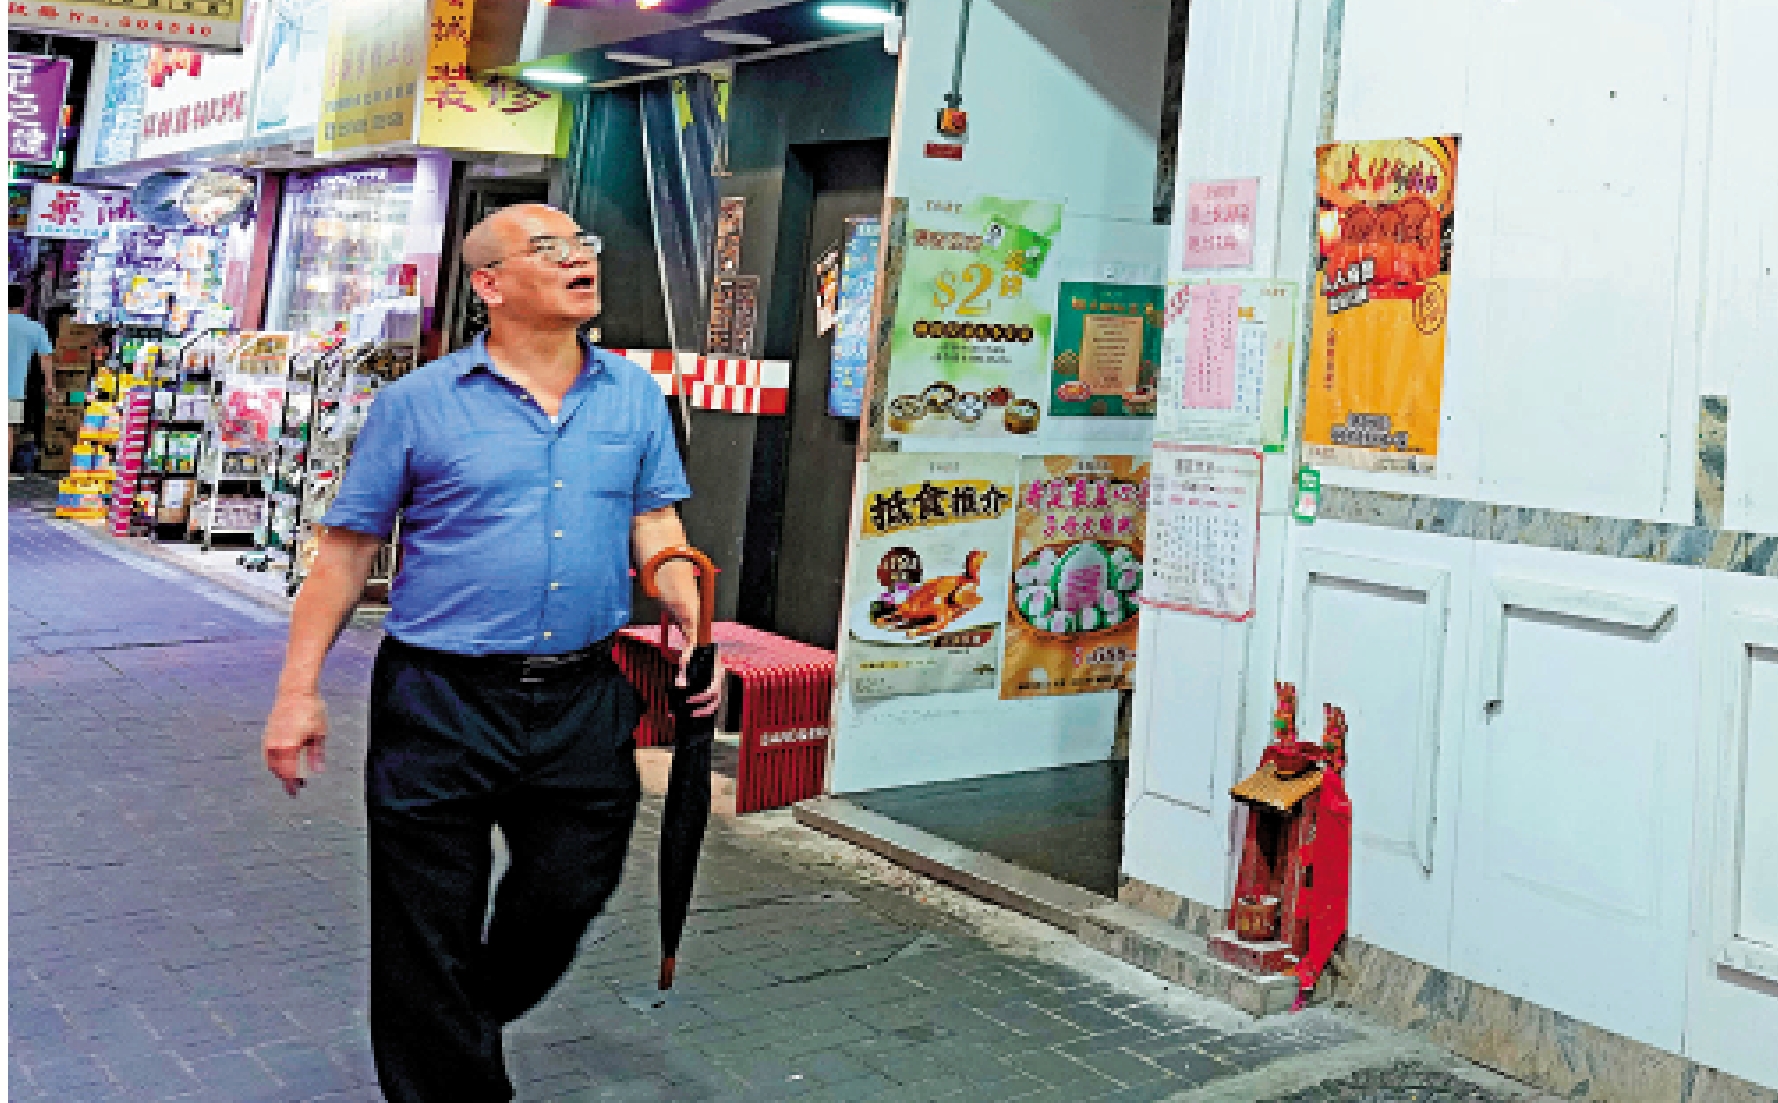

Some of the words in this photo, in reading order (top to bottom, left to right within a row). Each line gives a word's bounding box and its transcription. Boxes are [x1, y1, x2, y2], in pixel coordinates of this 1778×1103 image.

[931, 261, 995, 316] $2
[870, 480, 1009, 532] 抵食推介
